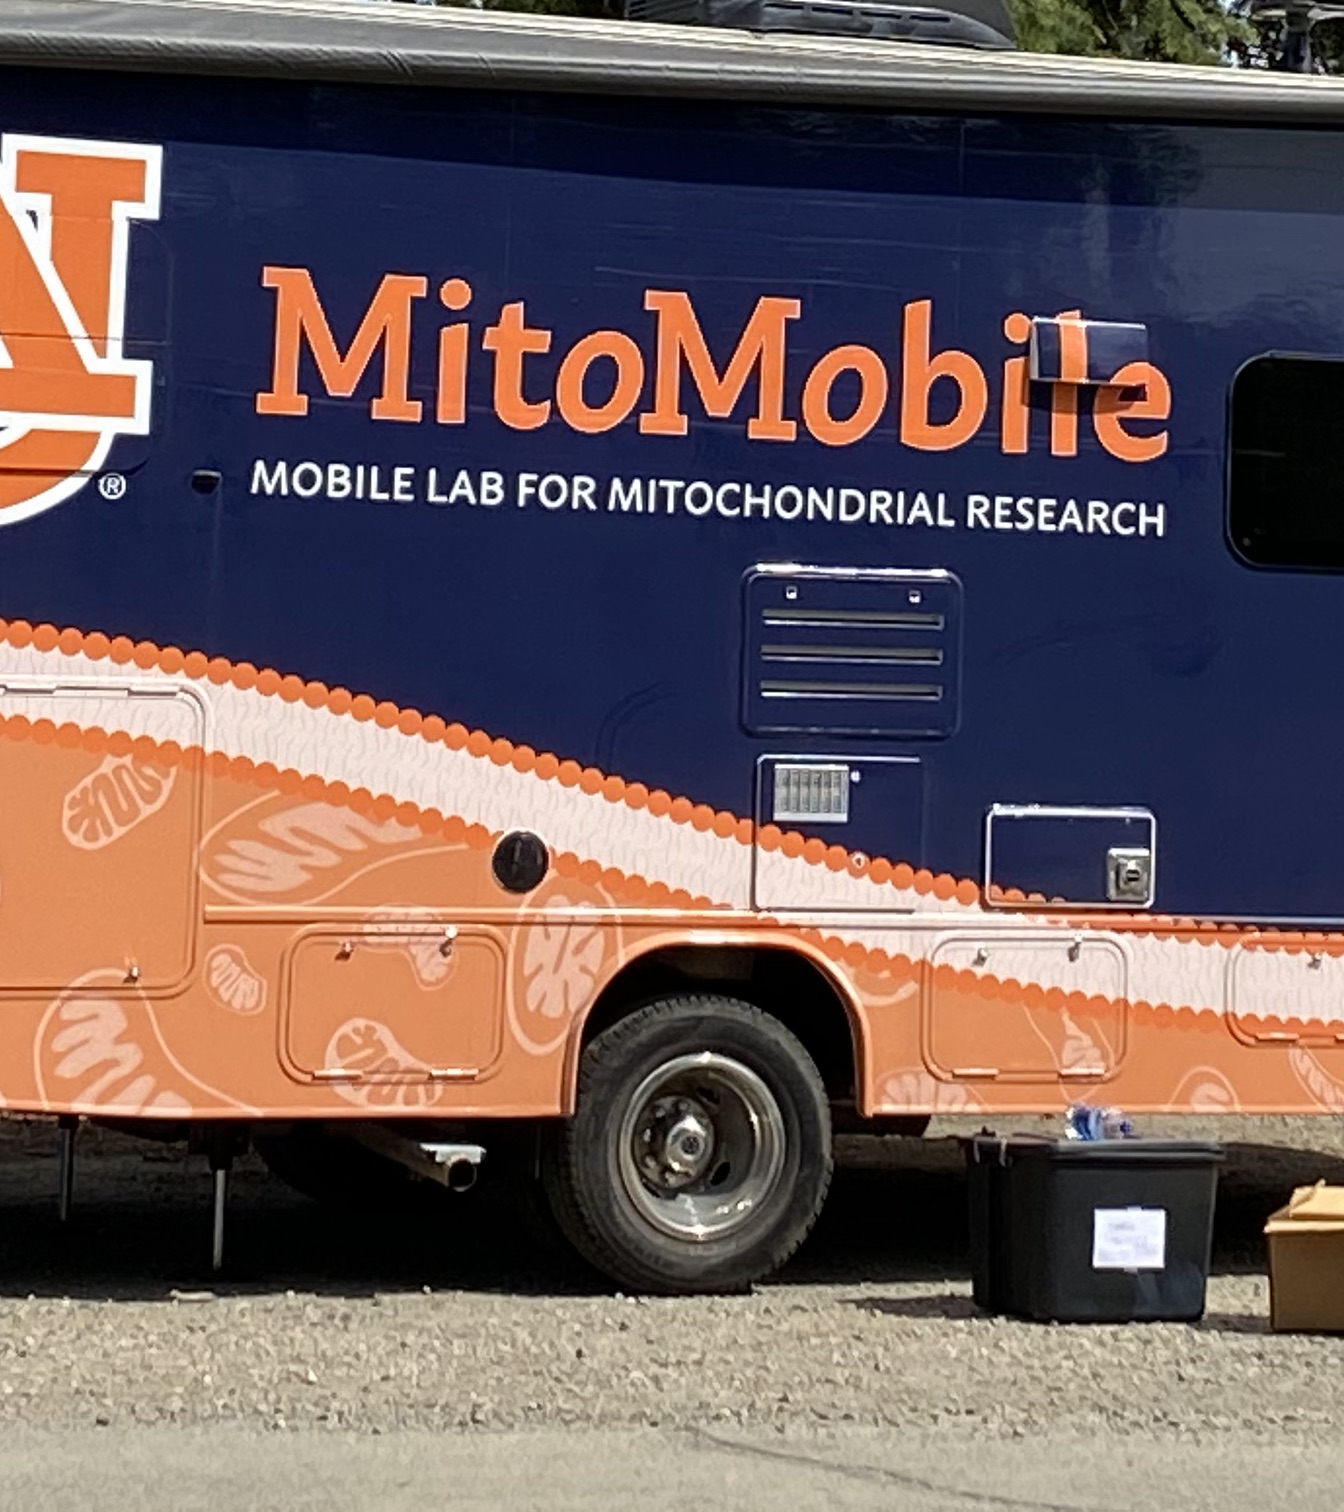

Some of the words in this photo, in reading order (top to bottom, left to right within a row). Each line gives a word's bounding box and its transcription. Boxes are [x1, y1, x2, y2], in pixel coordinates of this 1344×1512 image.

[255, 265, 1172, 463] MitoMobile
[251, 459, 415, 502] MOBILE
[426, 467, 505, 507] LAB
[517, 473, 598, 511] FOR
[606, 477, 956, 528] MITOCHONDRIAL
[966, 494, 1167, 537] RESEARCH
